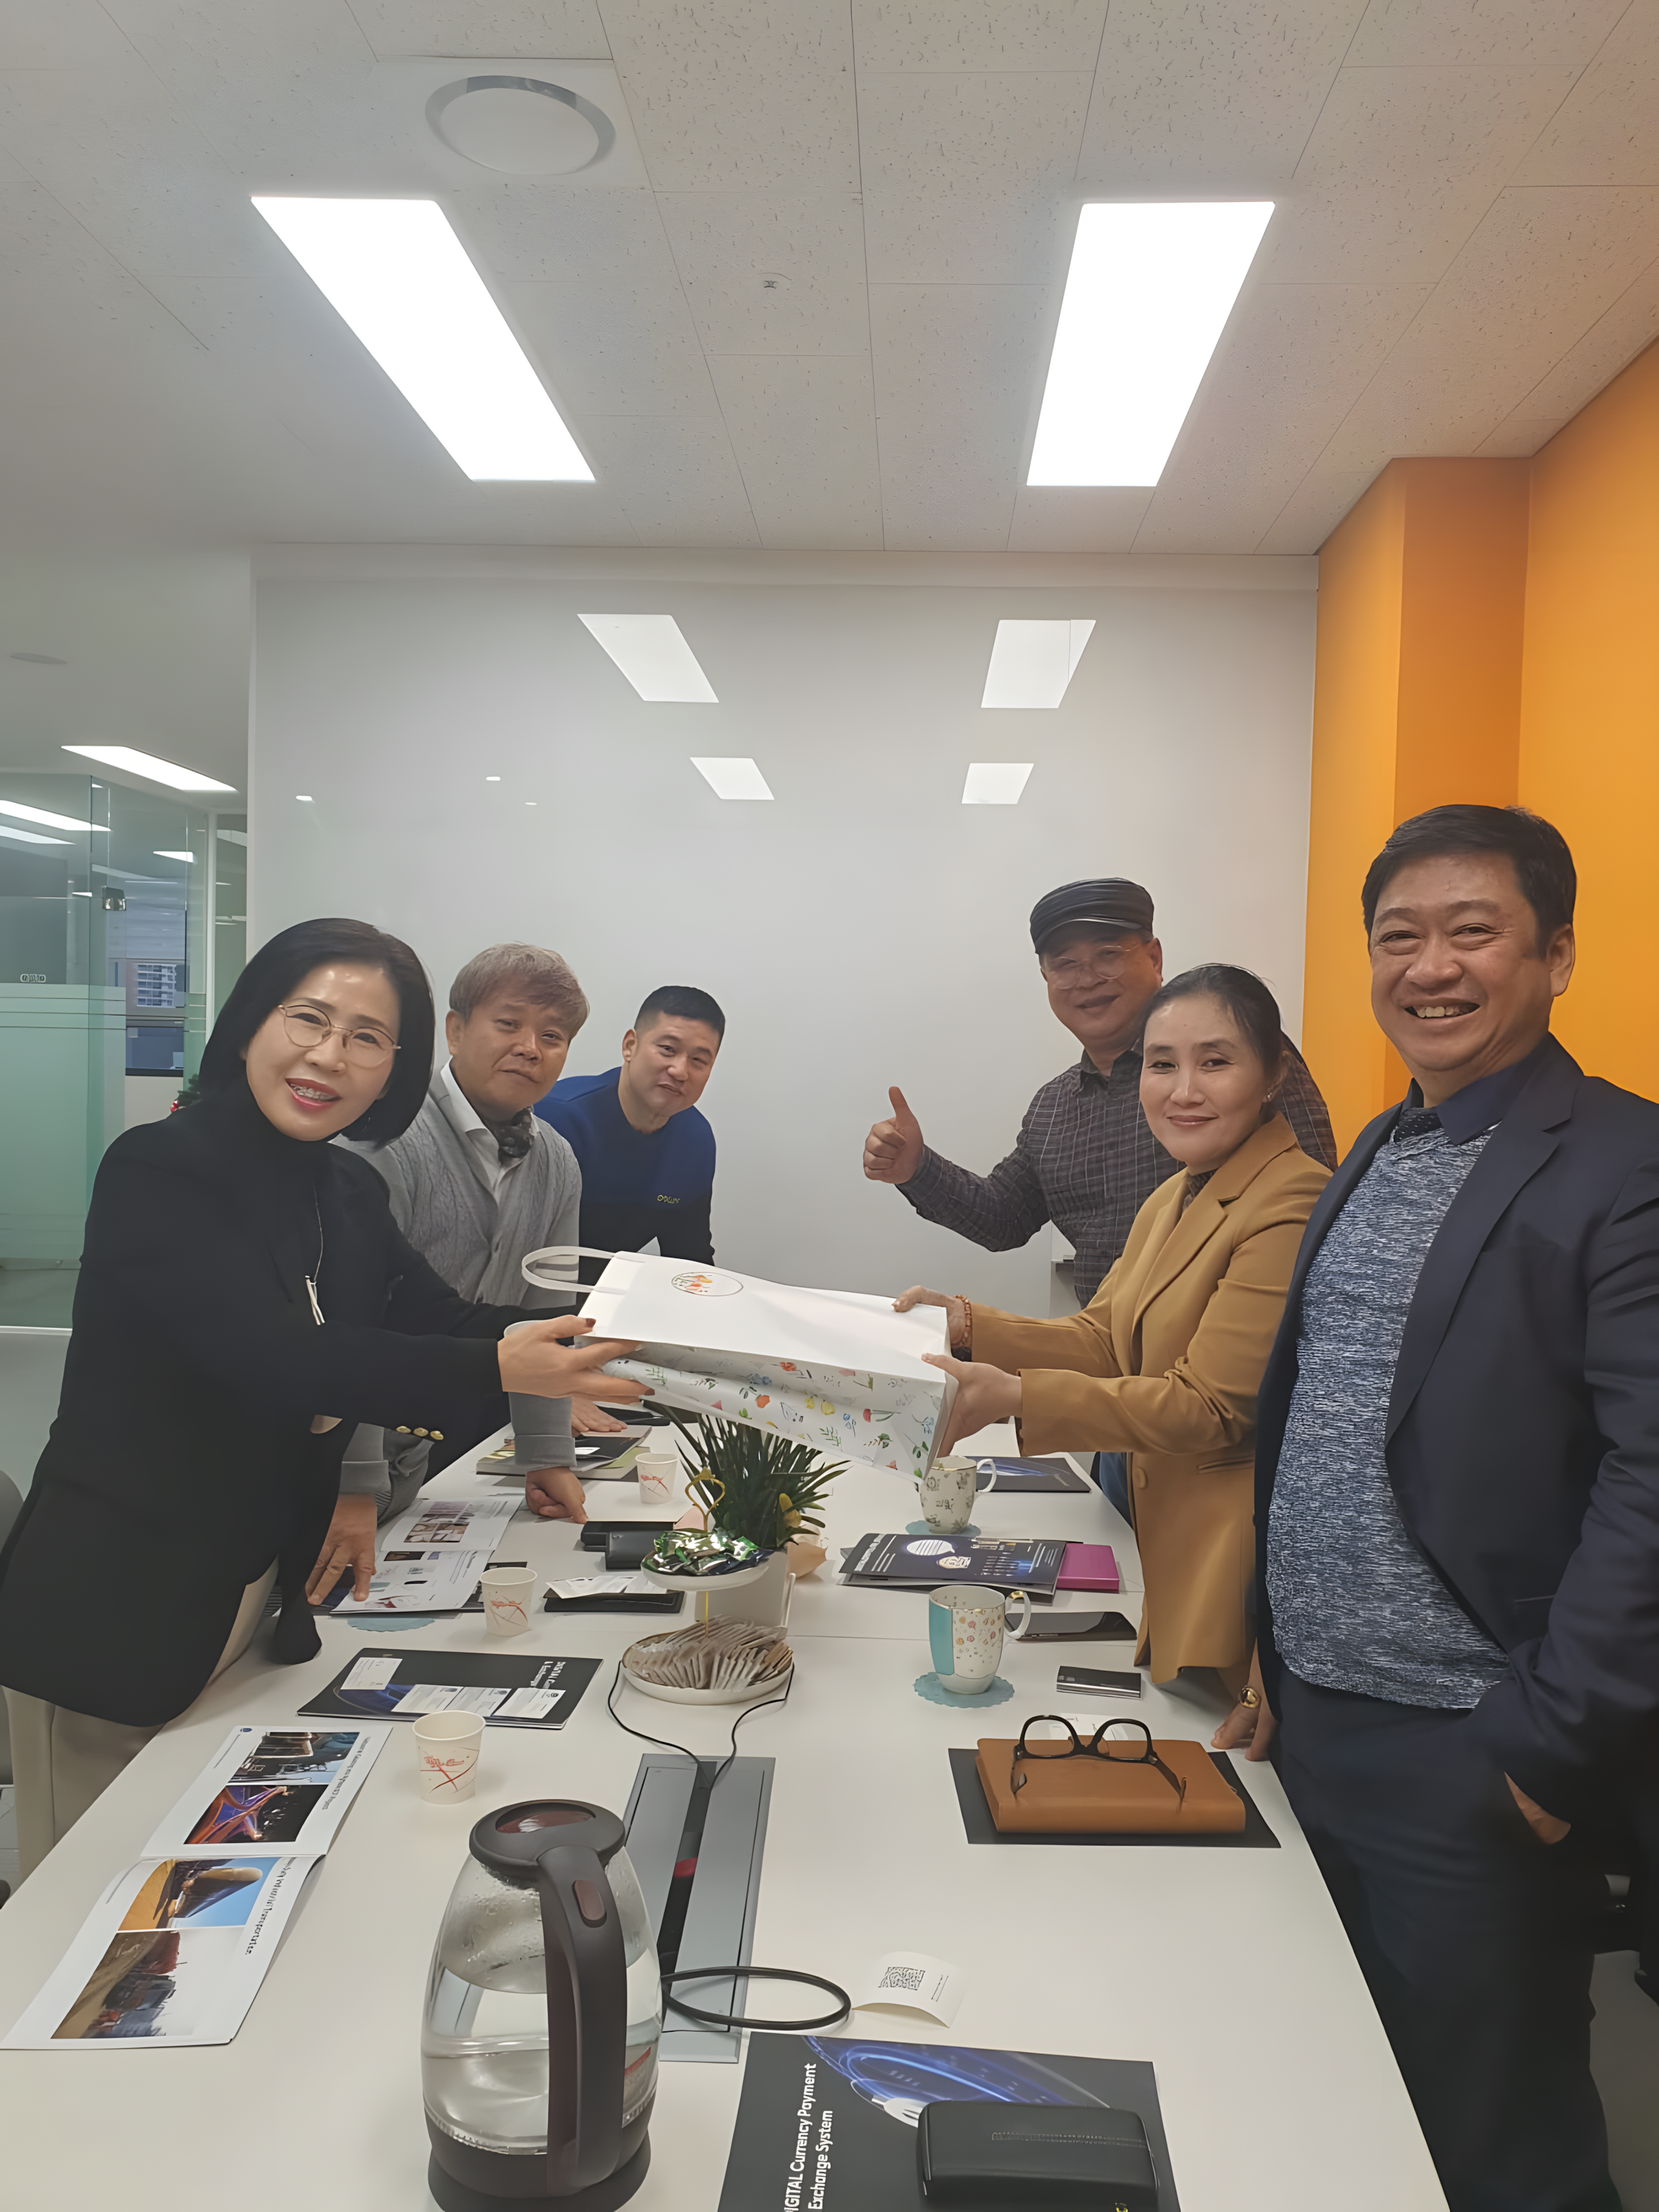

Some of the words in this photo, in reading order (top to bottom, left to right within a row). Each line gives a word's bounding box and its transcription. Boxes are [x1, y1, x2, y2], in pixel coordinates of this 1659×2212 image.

[797, 2063, 816, 2117] Payment
[789, 2118, 813, 2172] Currency
[815, 2110, 833, 2153] System
[784, 2173, 803, 2212] IGITAL
[807, 2154, 832, 2210] Exchange
